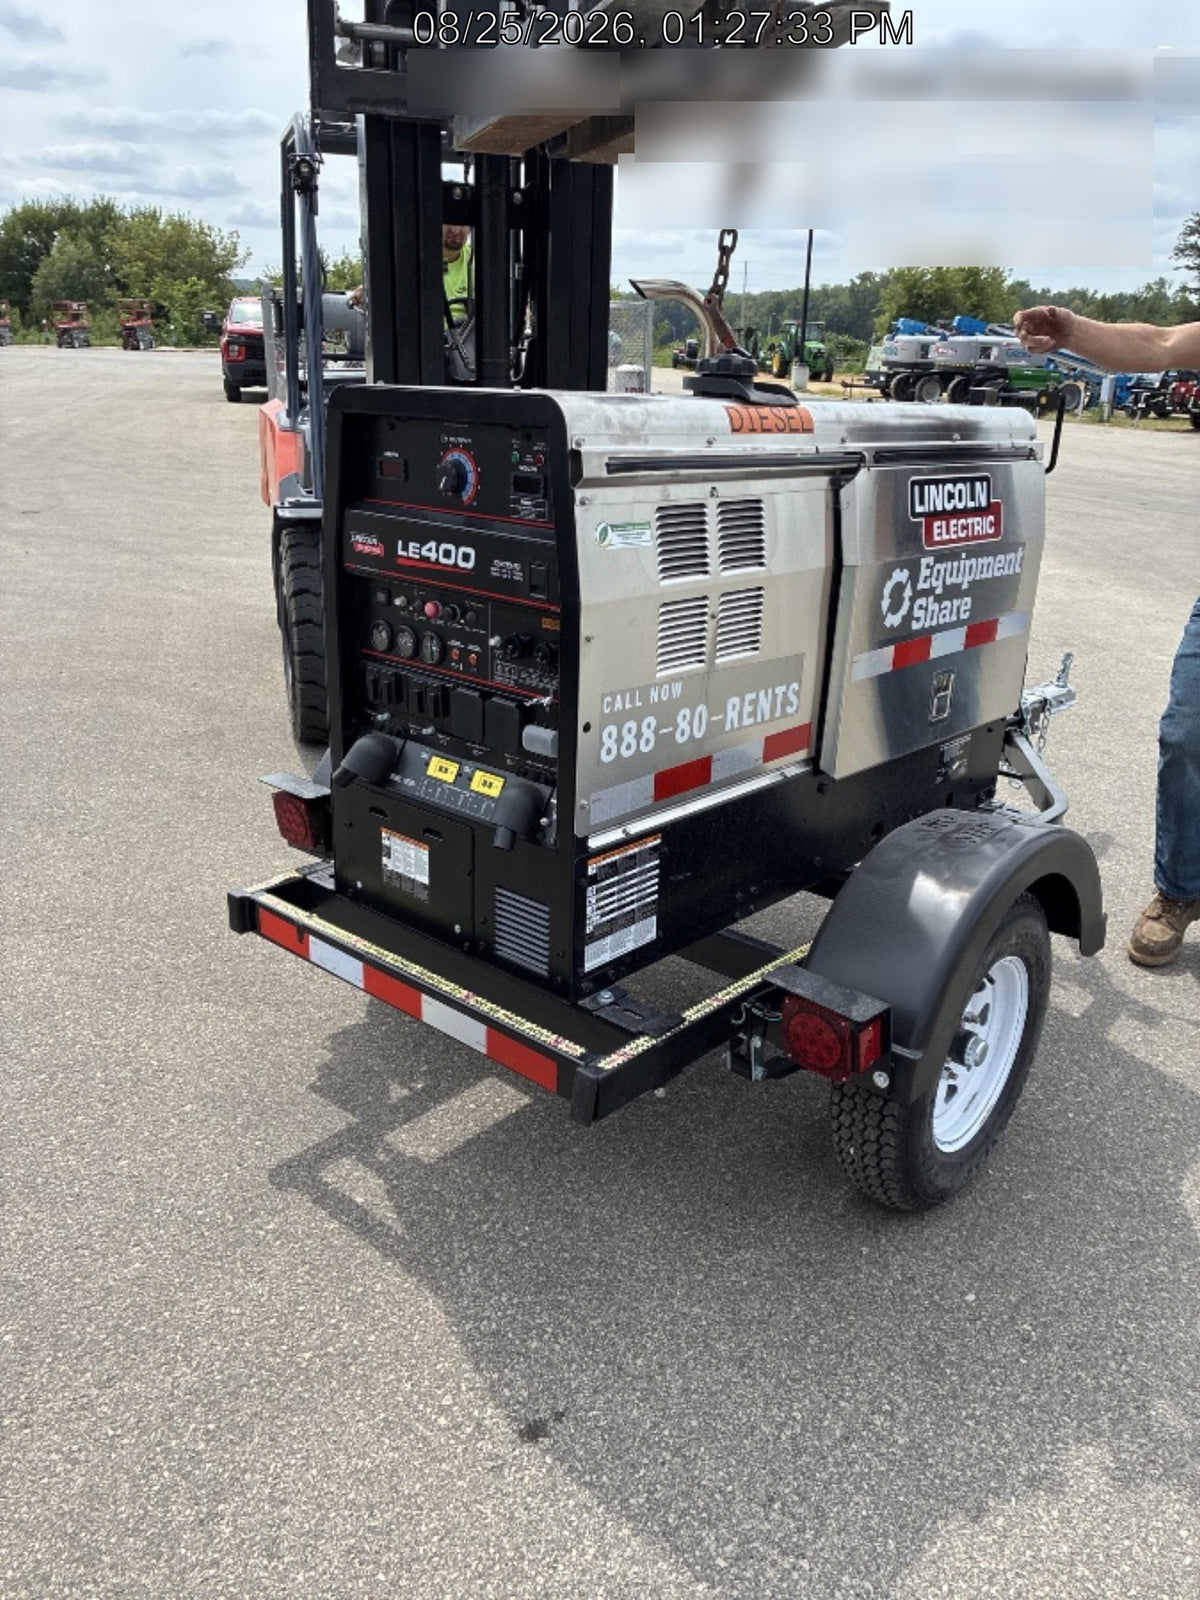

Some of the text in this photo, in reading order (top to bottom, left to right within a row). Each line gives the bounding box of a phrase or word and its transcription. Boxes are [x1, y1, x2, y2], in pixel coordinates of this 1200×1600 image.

[727, 405, 814, 433] DIESEL
[913, 481, 988, 513] LINCOLN
[932, 515, 995, 541] ELECTRIC
[397, 539, 476, 570] LE400
[916, 547, 1025, 595] Equipment
[911, 596, 972, 630] Share
[603, 681, 683, 714] CALL NOW
[599, 681, 801, 764] 888-80-RENTS
